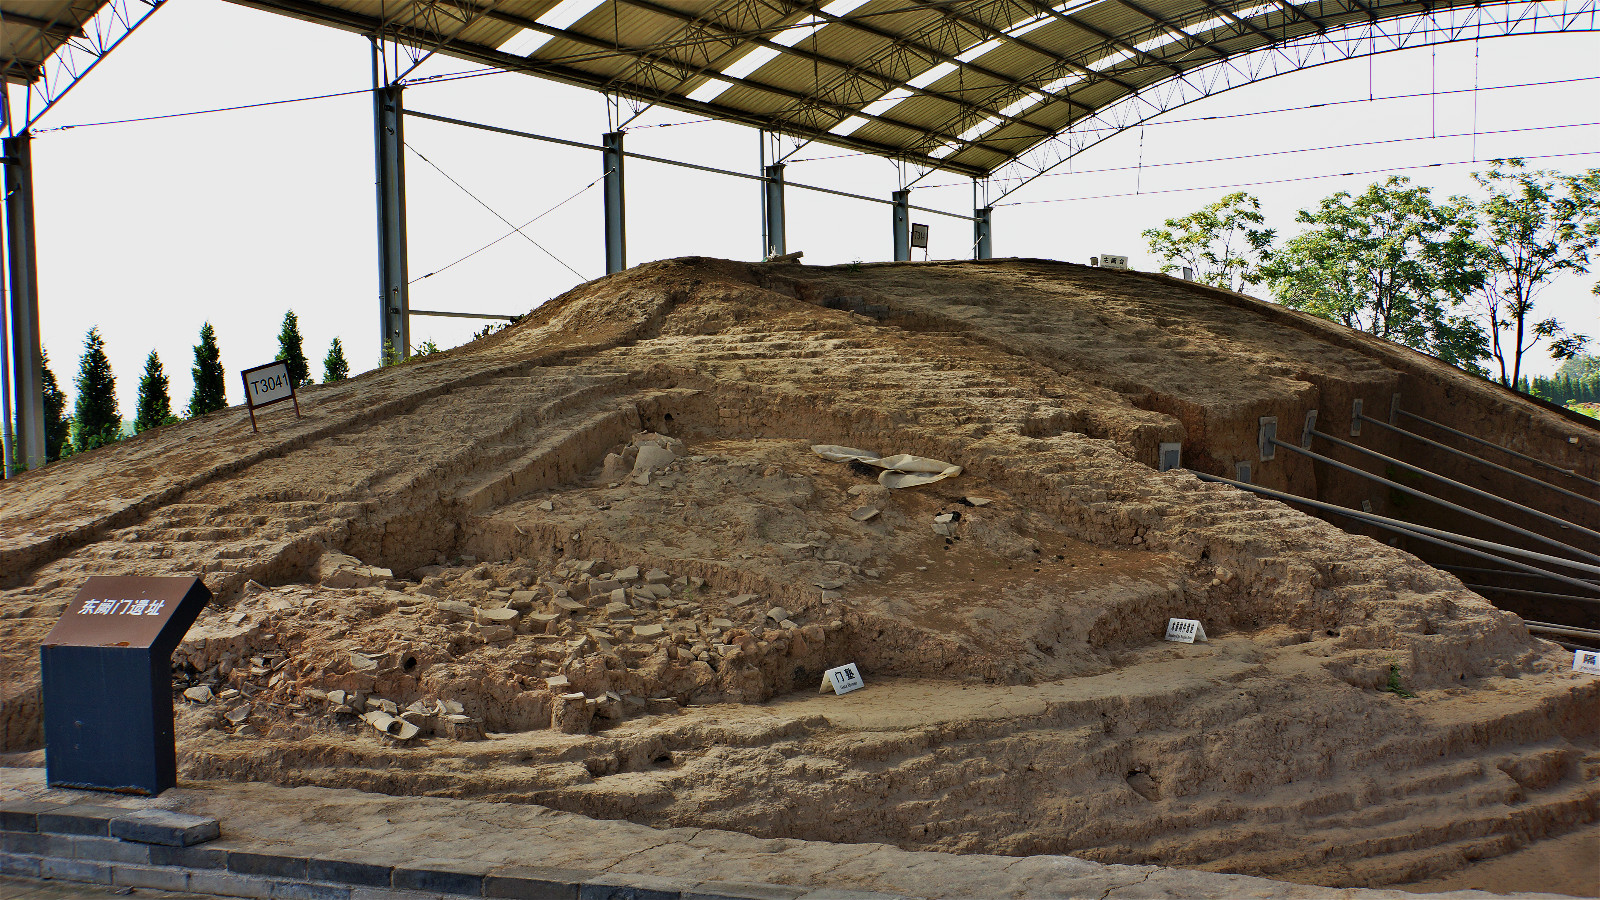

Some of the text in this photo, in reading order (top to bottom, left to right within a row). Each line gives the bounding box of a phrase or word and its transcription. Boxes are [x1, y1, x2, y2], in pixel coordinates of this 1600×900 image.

[250, 372, 288, 395] T3041
[77, 598, 165, 616] 东阙门遗址
